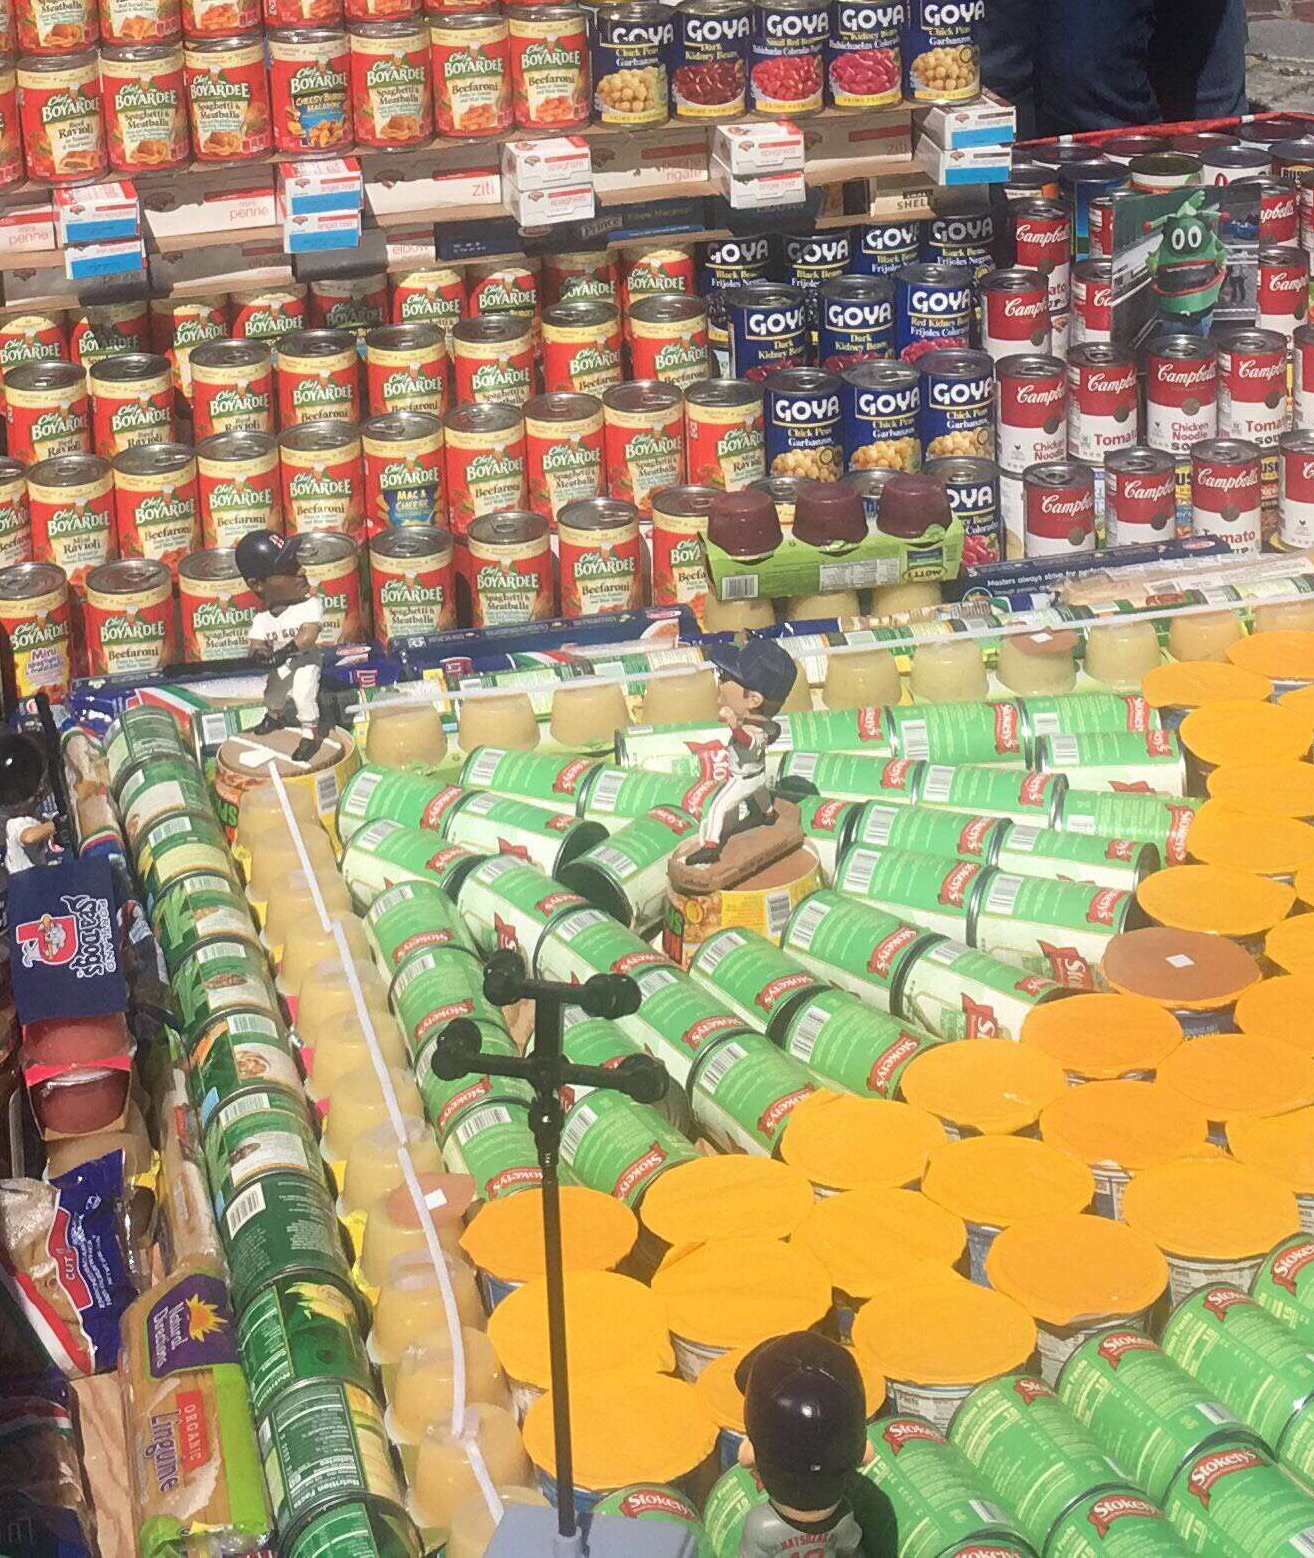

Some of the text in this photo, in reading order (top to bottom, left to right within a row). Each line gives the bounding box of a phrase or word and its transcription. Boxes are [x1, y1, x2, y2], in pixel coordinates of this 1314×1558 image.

[766, 11, 828, 37] GOYA
[842, 3, 904, 28] GOYA
[687, 16, 750, 41] GOYA
[448, 51, 469, 62] Chef
[444, 57, 503, 75] BOYARDEE
[451, 81, 499, 93] Beefaroni
[528, 73, 575, 86] Beefaroni
[127, 119, 168, 128] Meatballs
[229, 206, 269, 223] penne
[9, 231, 49, 246] penne
[850, 334, 872, 342] Dark
[835, 342, 864, 353] Kidney
[1171, 422, 1209, 432] Chicken
[1172, 432, 1208, 441] Noodle
[294, 473, 312, 486] Chef
[297, 504, 345, 515] Beefaroni
[574, 557, 635, 575] BOYARDEE
[60, 895, 105, 978] Sea Dogs
[96, 898, 117, 973] PORTLAND
[65, 1255, 75, 1282] CUT
[167, 1300, 189, 1350] Natural
[182, 1403, 203, 1462] ORGANIC
[148, 1414, 179, 1492] Linguine
